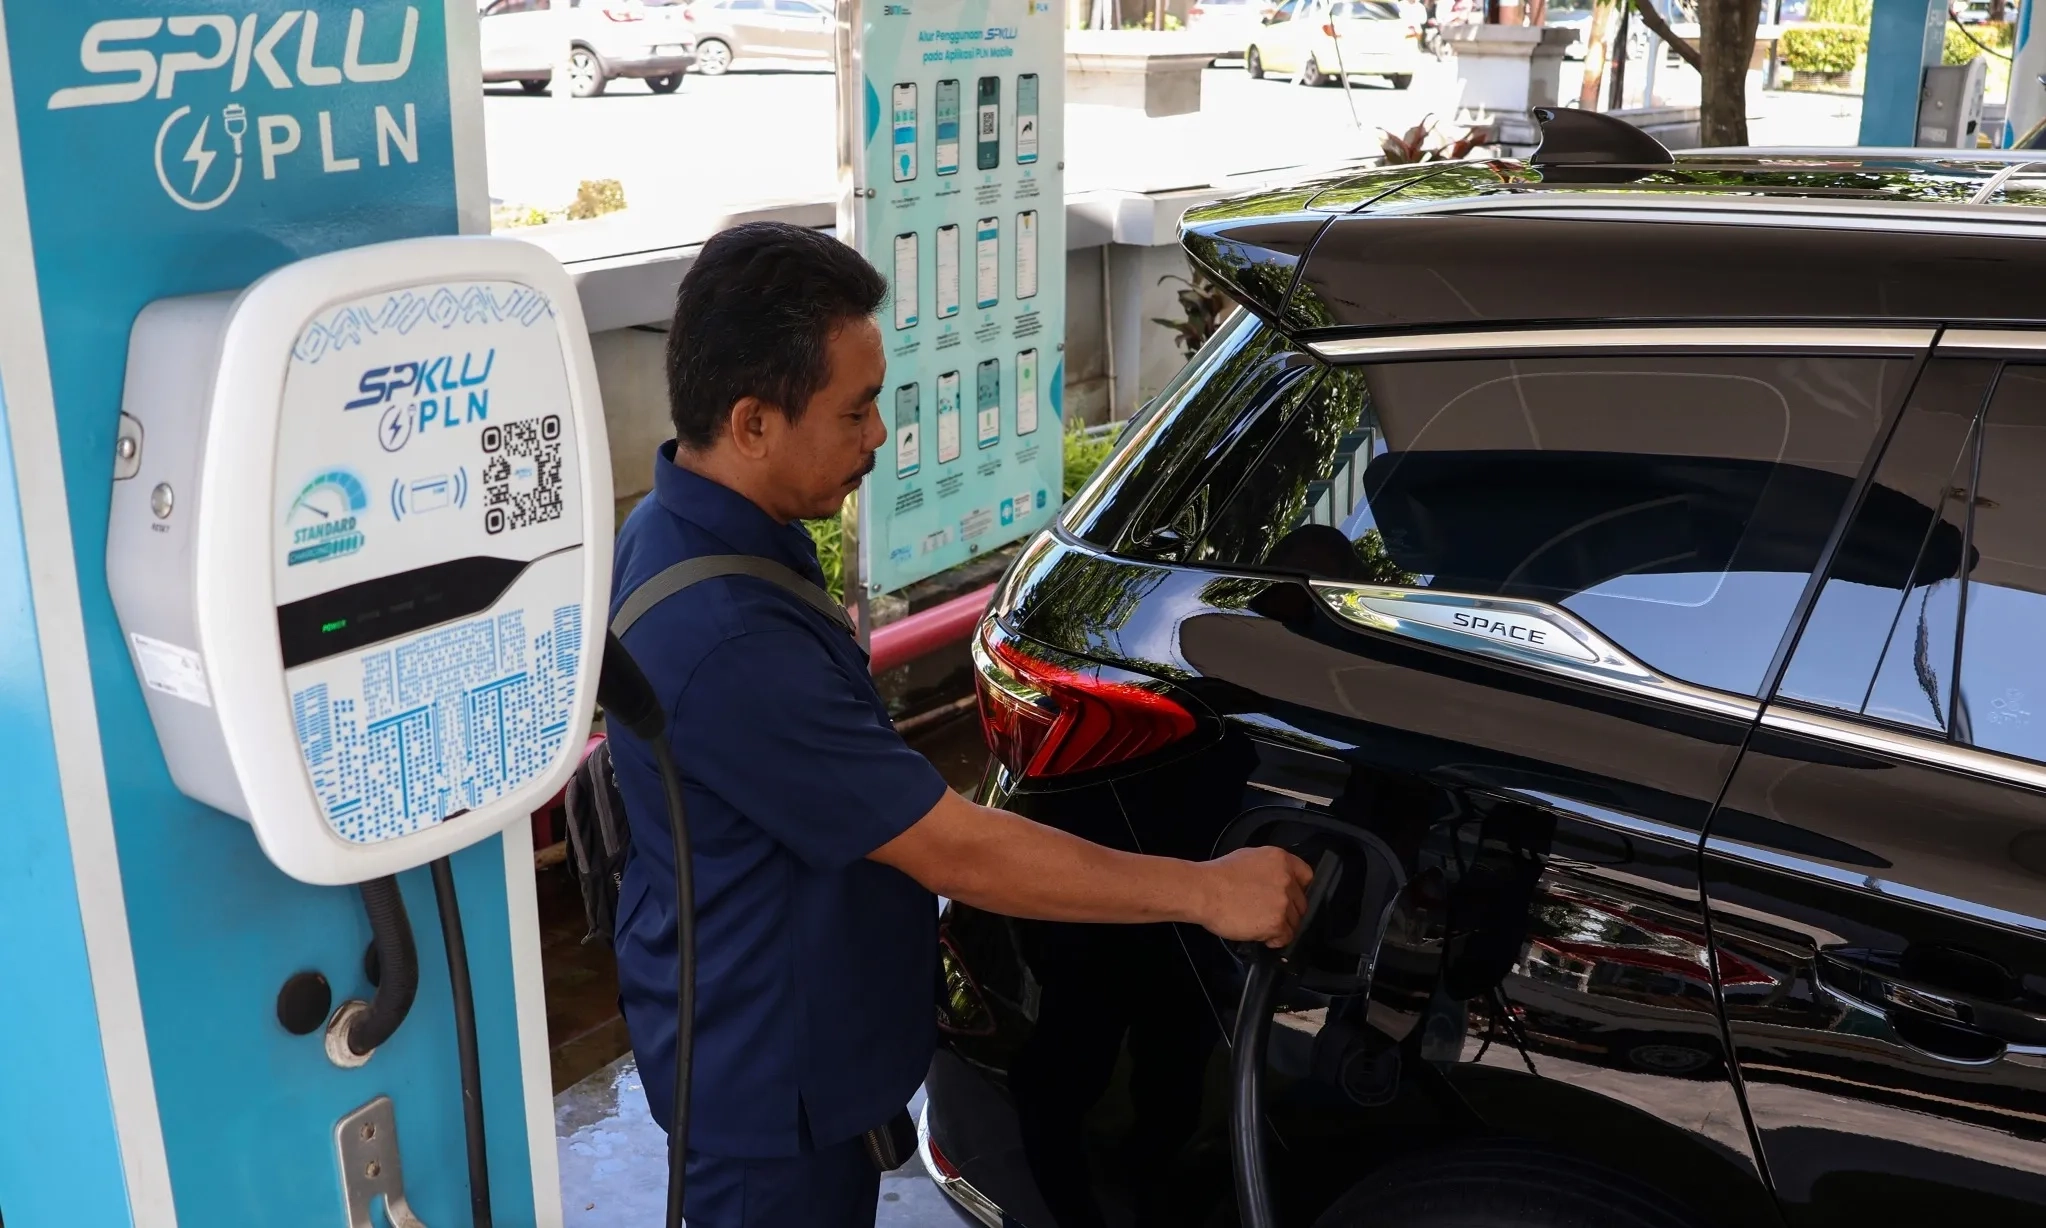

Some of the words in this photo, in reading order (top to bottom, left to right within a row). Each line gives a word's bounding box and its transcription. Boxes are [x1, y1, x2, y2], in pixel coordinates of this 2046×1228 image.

[918, 31, 935, 42] Alur
[936, 30, 983, 44] Penggunaan
[47, 7, 420, 110] SPKLU
[923, 50, 943, 65] pada
[990, 46, 1013, 58] Mobile
[257, 103, 419, 180] PLN
[343, 348, 495, 411] SPKLU
[418, 389, 489, 433] PLN
[294, 517, 357, 544] STANDARD
[321, 619, 347, 633] POWER
[1452, 612, 1547, 645] SPACE
